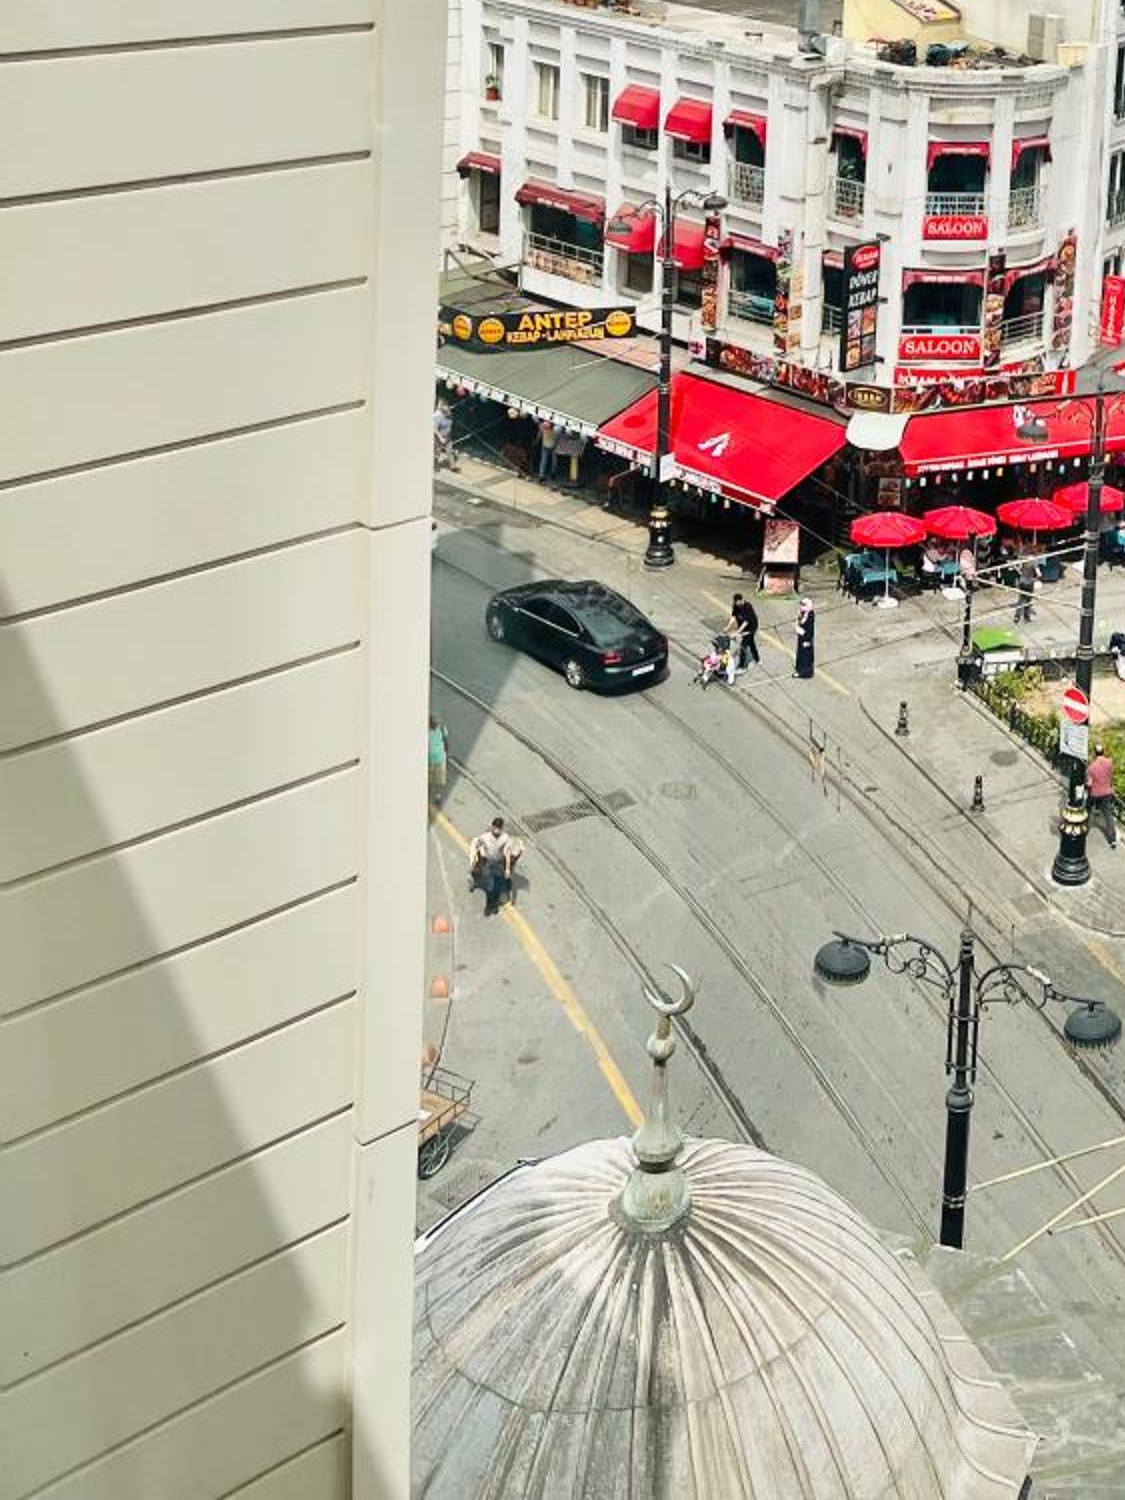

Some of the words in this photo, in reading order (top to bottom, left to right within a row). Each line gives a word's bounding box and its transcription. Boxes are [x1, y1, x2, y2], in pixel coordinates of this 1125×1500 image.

[927, 224, 983, 235] SALOON
[518, 310, 593, 331] ANTEP
[905, 340, 976, 354] SALOON
